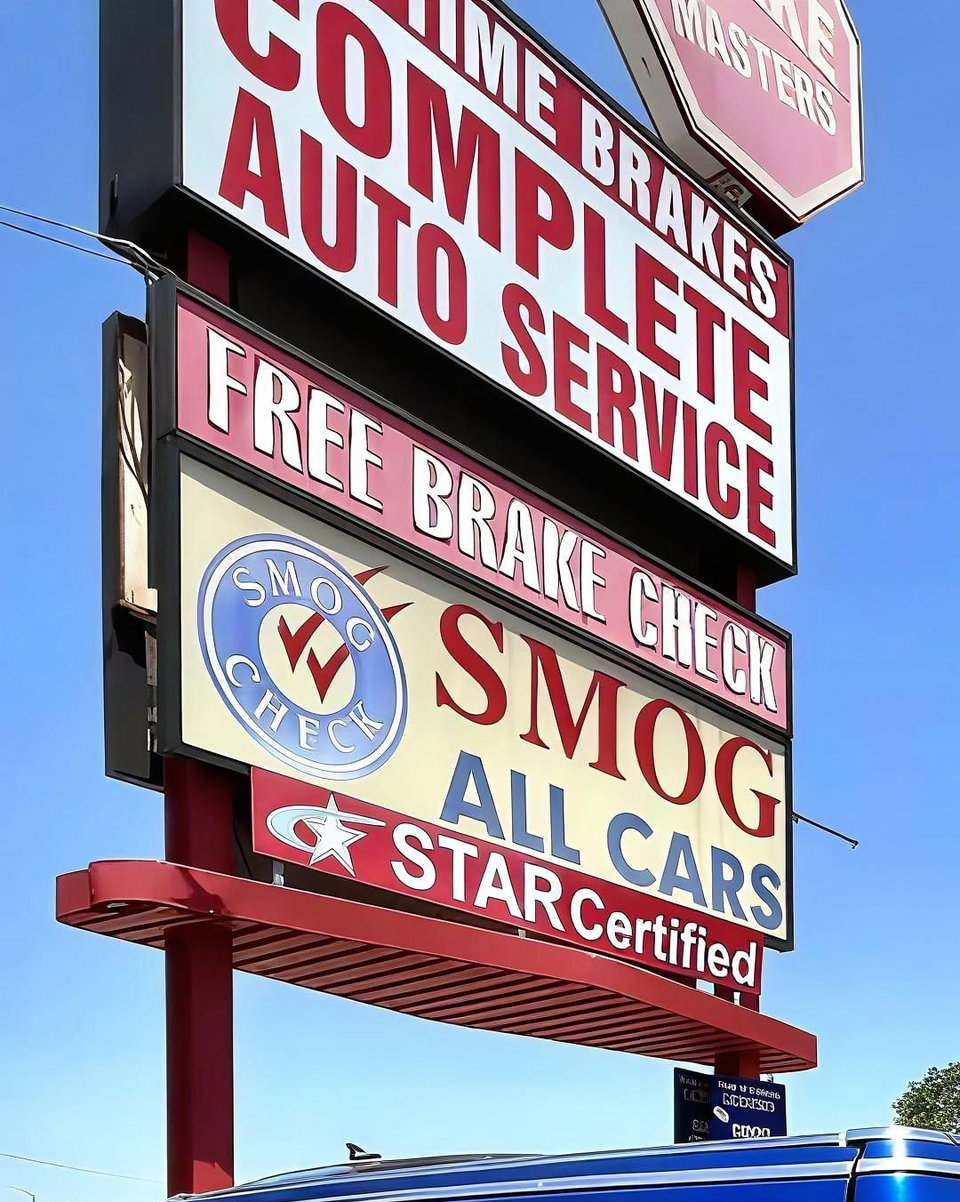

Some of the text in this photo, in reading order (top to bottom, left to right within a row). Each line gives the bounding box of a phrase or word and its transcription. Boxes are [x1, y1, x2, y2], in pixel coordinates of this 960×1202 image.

[671, 0, 837, 136] MASTERS
[214, 0, 773, 444] COMPLETE
[581, 97, 777, 318] BRAKES
[218, 86, 776, 548] AUTO SERVICE
[207, 326, 778, 713] FREE BRAKE CHECK
[231, 558, 375, 653] SMOG
[225, 654, 384, 753] CHECK
[435, 603, 782, 838] SMOG
[390, 822, 757, 987] STAR Certified
[439, 750, 783, 931] ALL CARS
